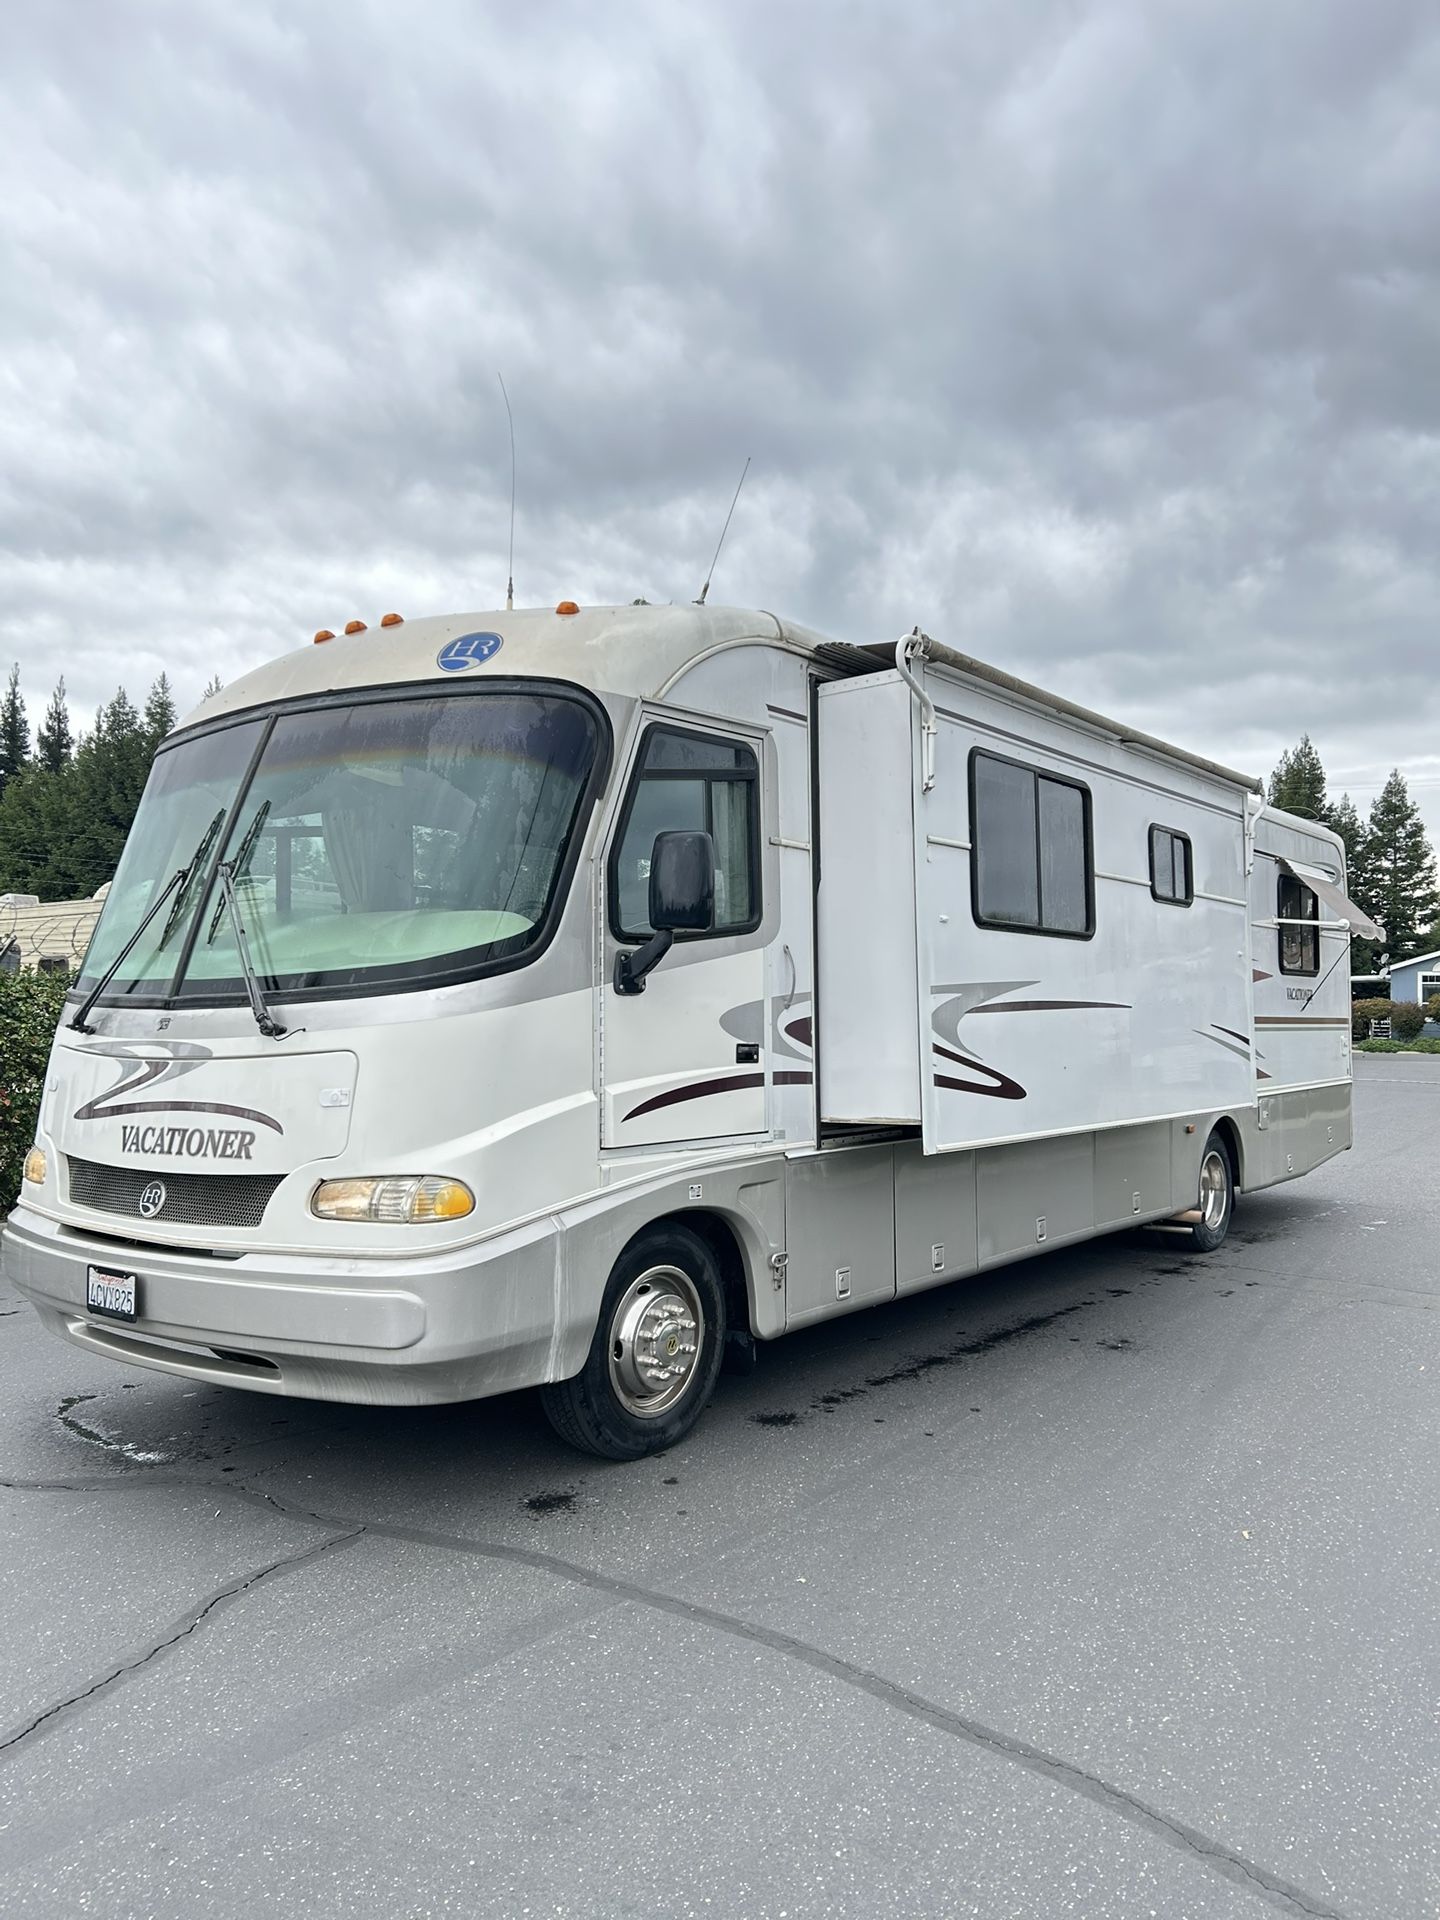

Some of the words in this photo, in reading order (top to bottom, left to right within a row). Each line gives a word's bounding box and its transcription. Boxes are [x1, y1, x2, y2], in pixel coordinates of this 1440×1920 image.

[447, 639, 495, 657] HR
[121, 1125, 256, 1160] VACATIONER
[143, 1188, 161, 1203] HR
[90, 1283, 133, 1313] 4CVX825
